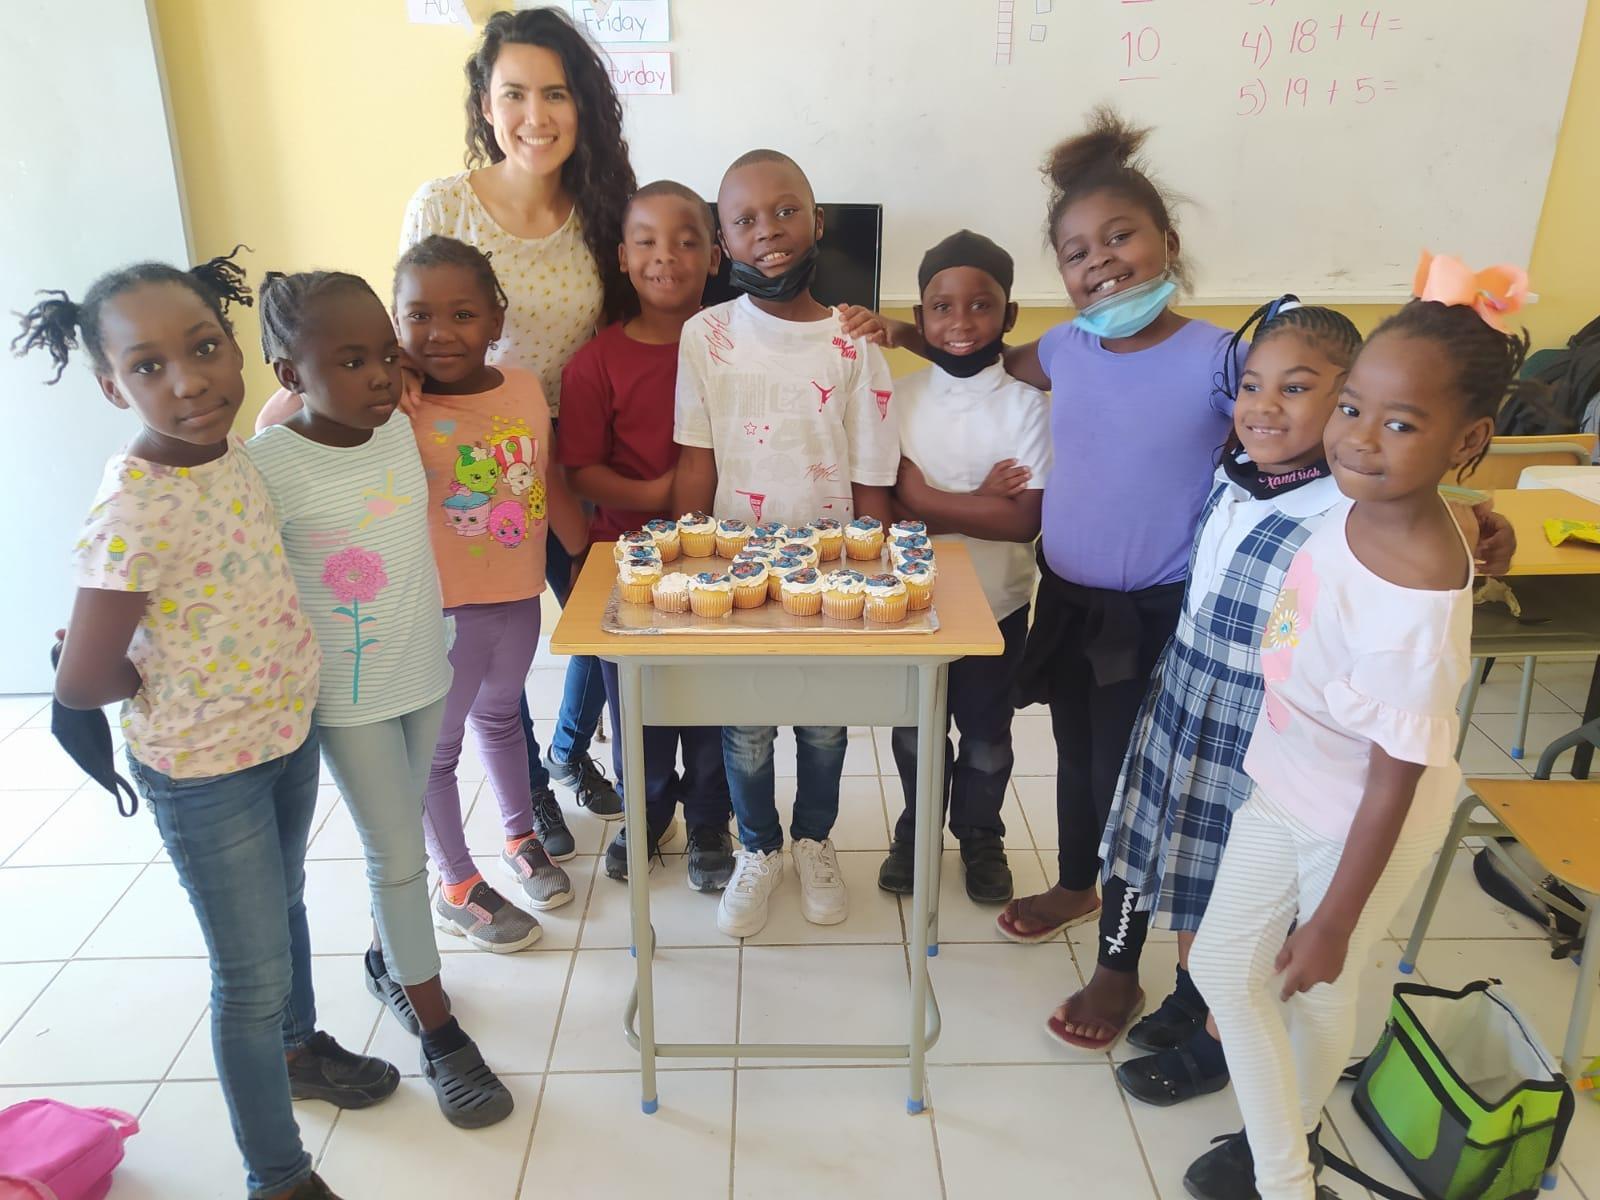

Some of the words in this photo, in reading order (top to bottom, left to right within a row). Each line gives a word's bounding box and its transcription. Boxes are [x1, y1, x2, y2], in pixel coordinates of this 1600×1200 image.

[582, 6, 648, 41] Friday
[1241, 24, 1273, 69] 4)
[1289, 18, 1318, 54] 18
[1121, 26, 1161, 68] 10
[608, 59, 666, 90] turday
[1236, 77, 1267, 117] 5)
[1285, 76, 1309, 107] 19
